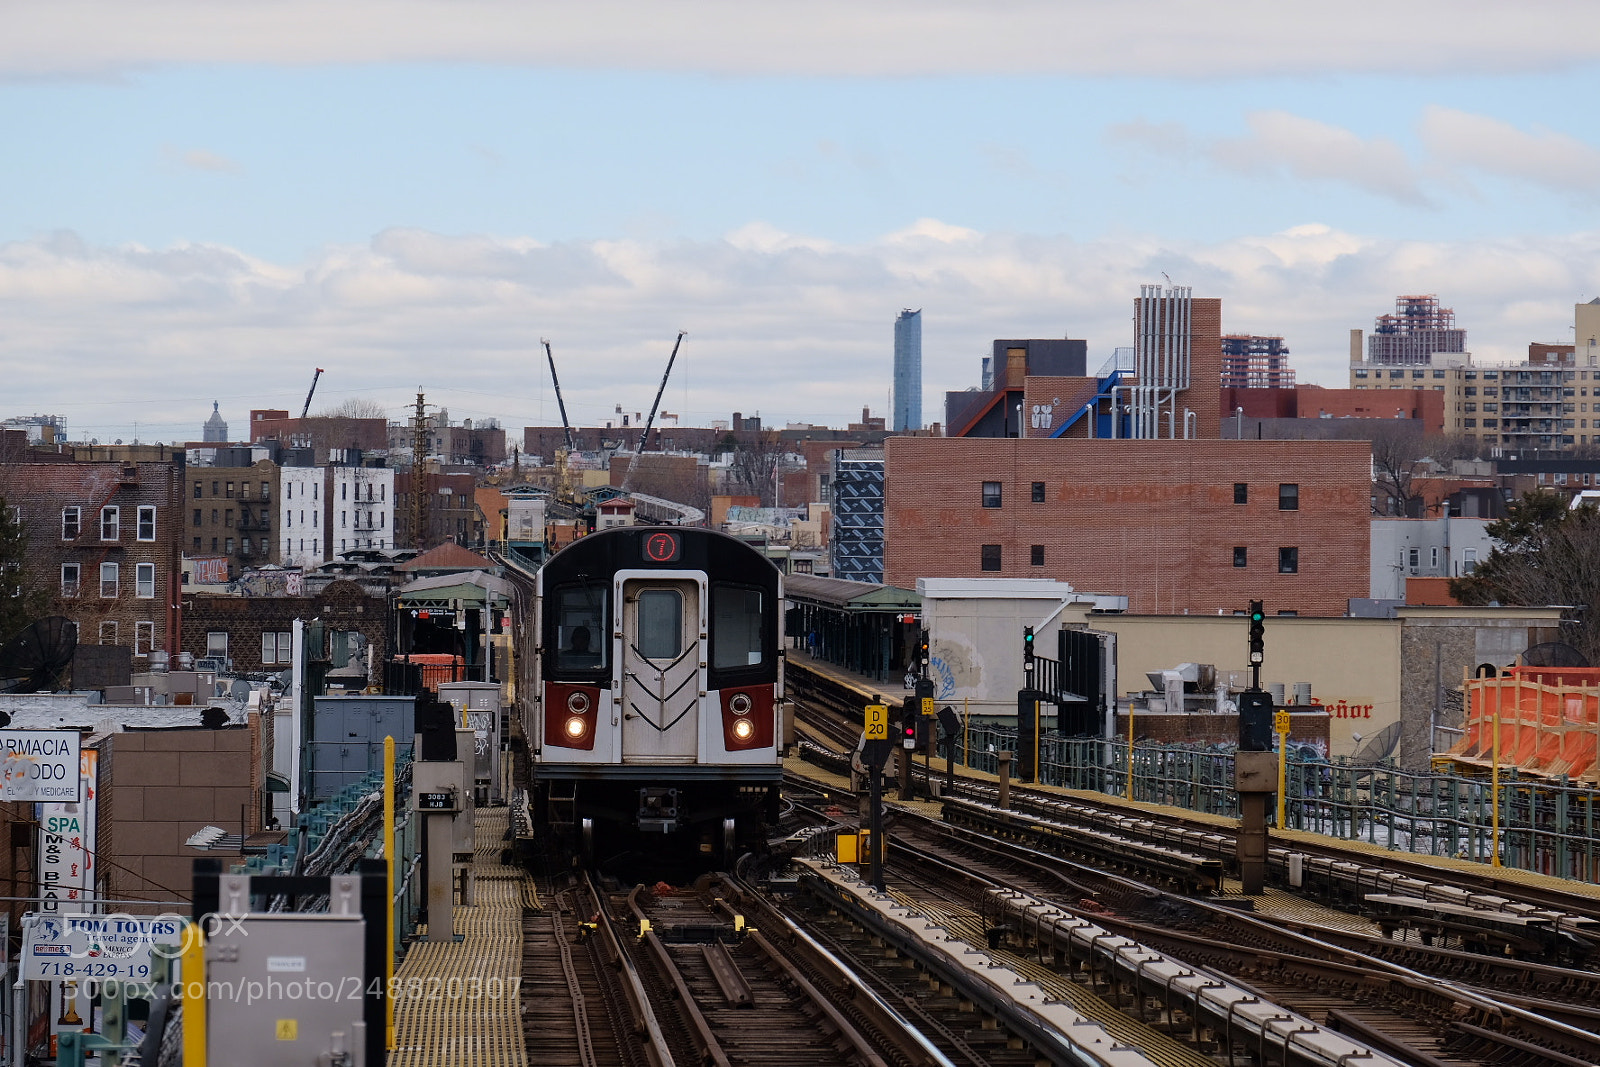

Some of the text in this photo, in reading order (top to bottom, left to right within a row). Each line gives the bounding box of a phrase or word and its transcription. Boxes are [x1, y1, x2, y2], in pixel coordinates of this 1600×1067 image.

[656, 539, 667, 556] 7
[872, 711, 880, 722] D
[1277, 715, 1289, 724] 30
[869, 724, 884, 735] 20
[41, 787, 74, 797] MEDICARE
[48, 817, 80, 833] SPA
[43, 872, 60, 914] BEAU
[69, 919, 175, 935] TOM TOURS
[85, 933, 157, 944] Travel agency
